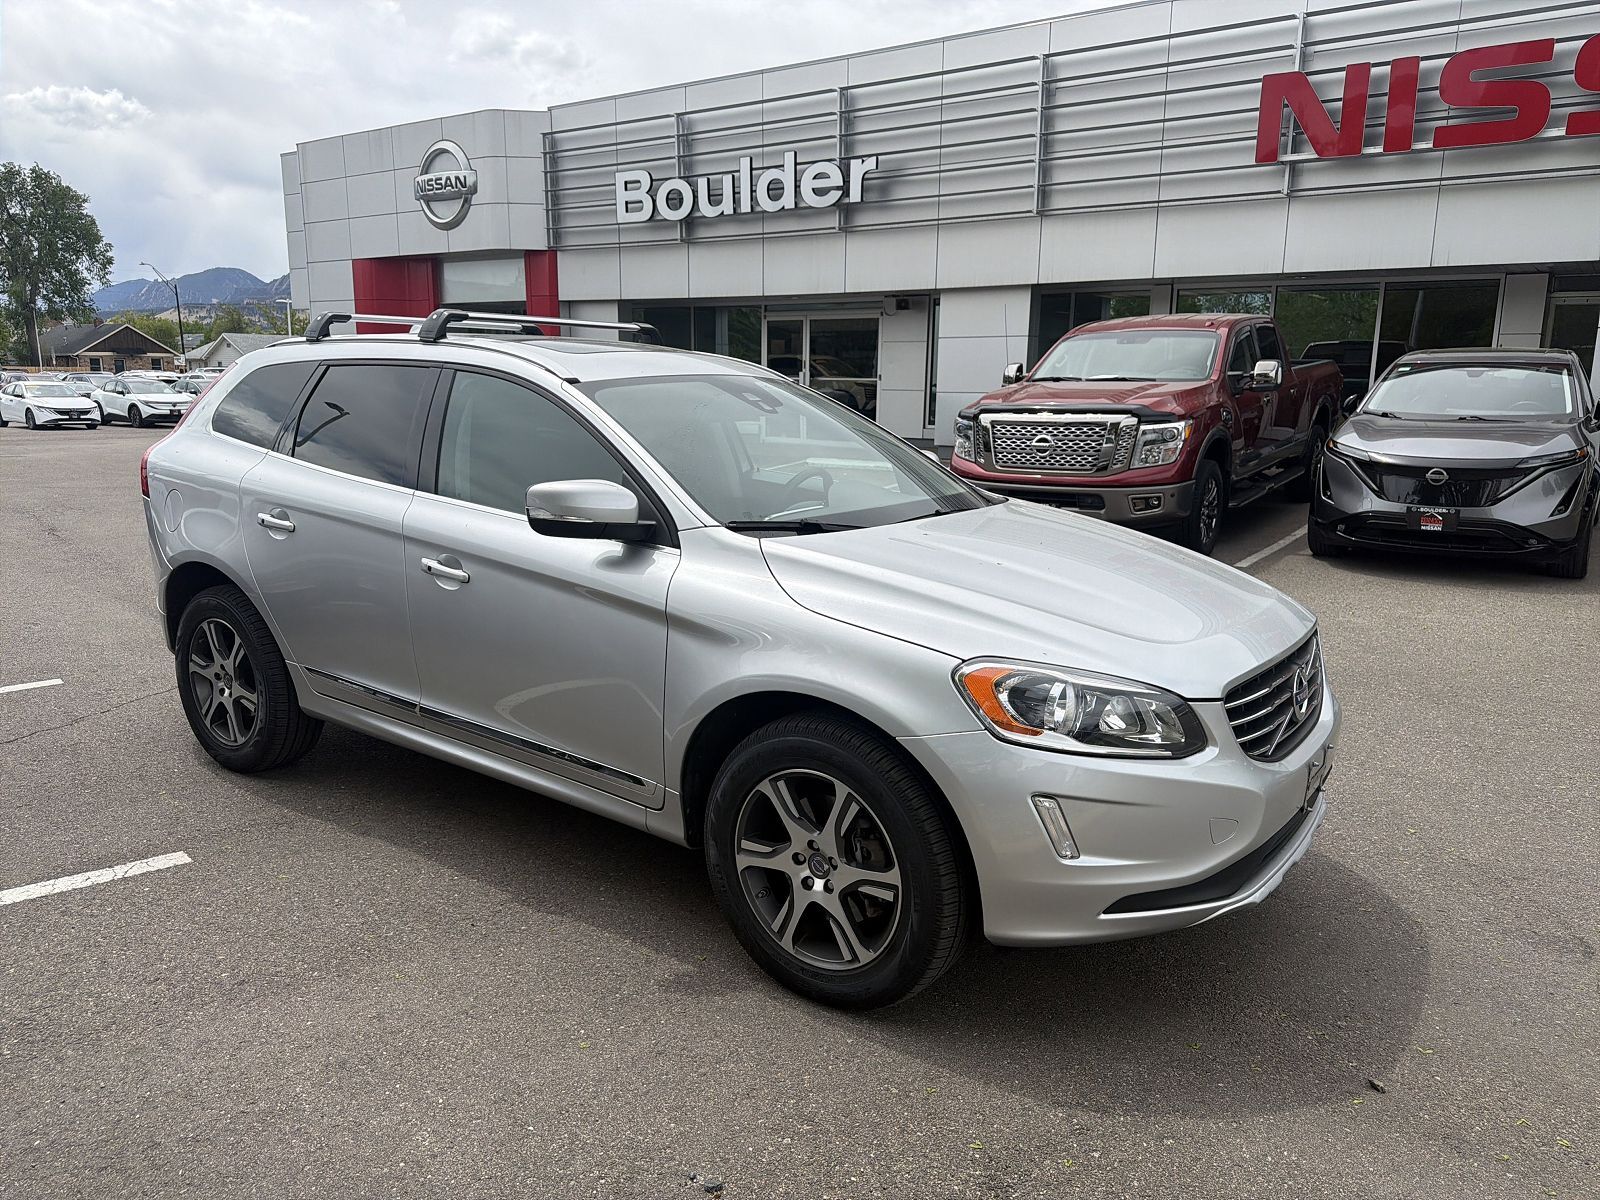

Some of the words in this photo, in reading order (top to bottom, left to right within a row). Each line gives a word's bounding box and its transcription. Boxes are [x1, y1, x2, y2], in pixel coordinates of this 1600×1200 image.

[1255, 33, 1600, 164] NIS
[416, 175, 467, 194] NISSAN
[615, 151, 878, 224] Boulder
